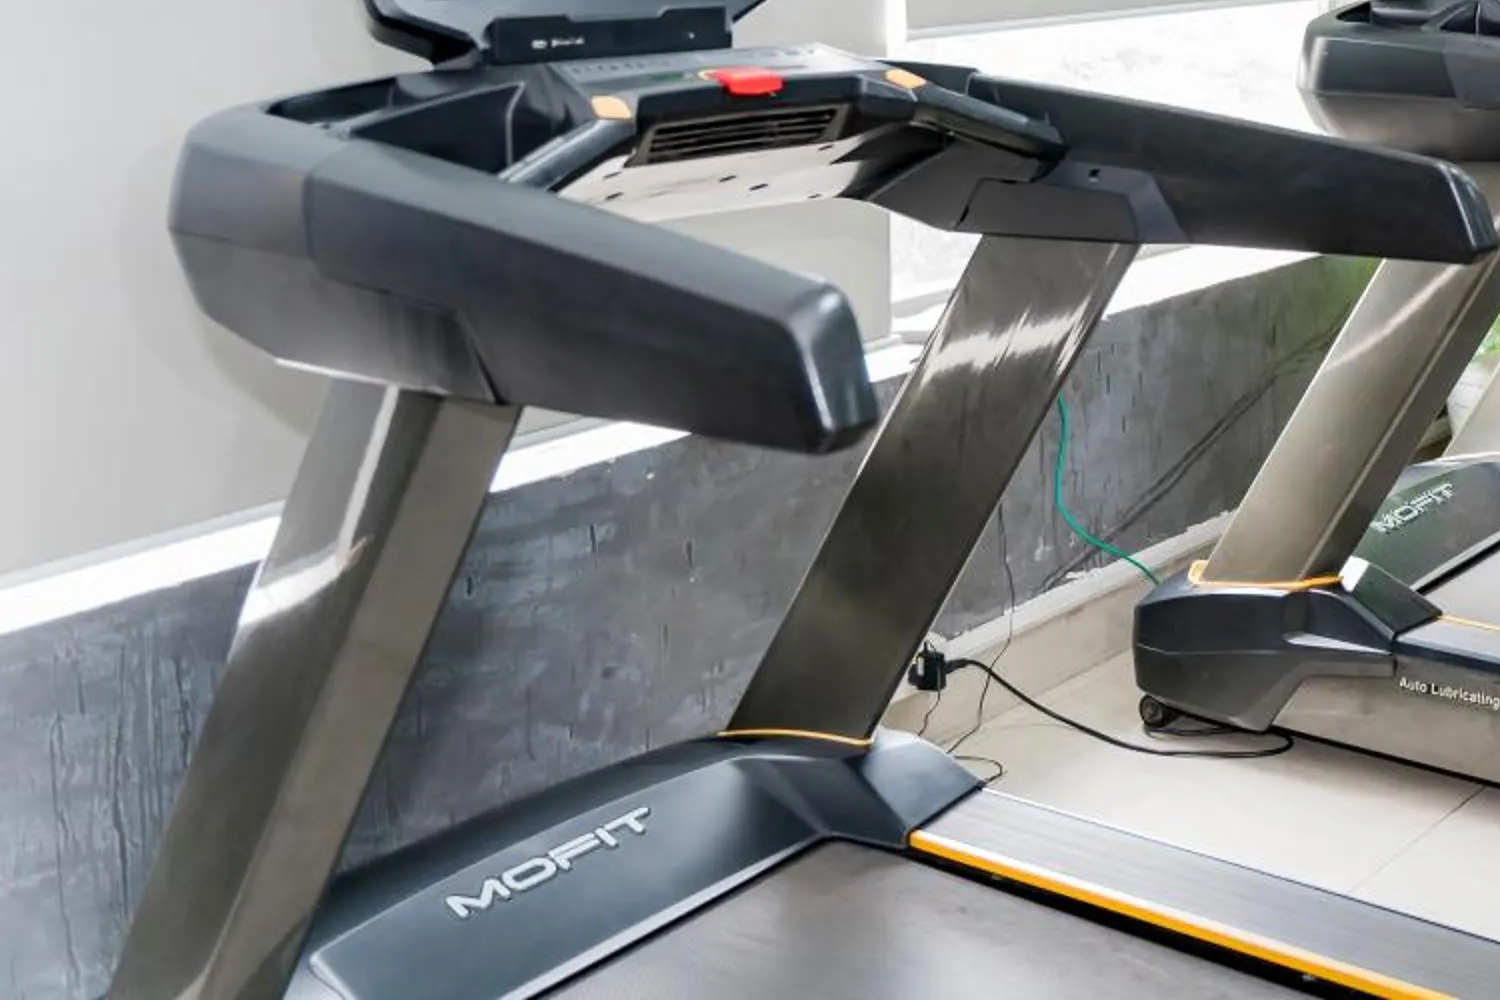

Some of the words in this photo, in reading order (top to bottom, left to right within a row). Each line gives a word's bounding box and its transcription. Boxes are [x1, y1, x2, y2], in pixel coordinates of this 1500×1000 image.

[1369, 483, 1453, 534] MOFIT
[1399, 676, 1428, 694] Auto
[1431, 682, 1500, 711] Lubricating
[446, 807, 649, 918] MOFIT
